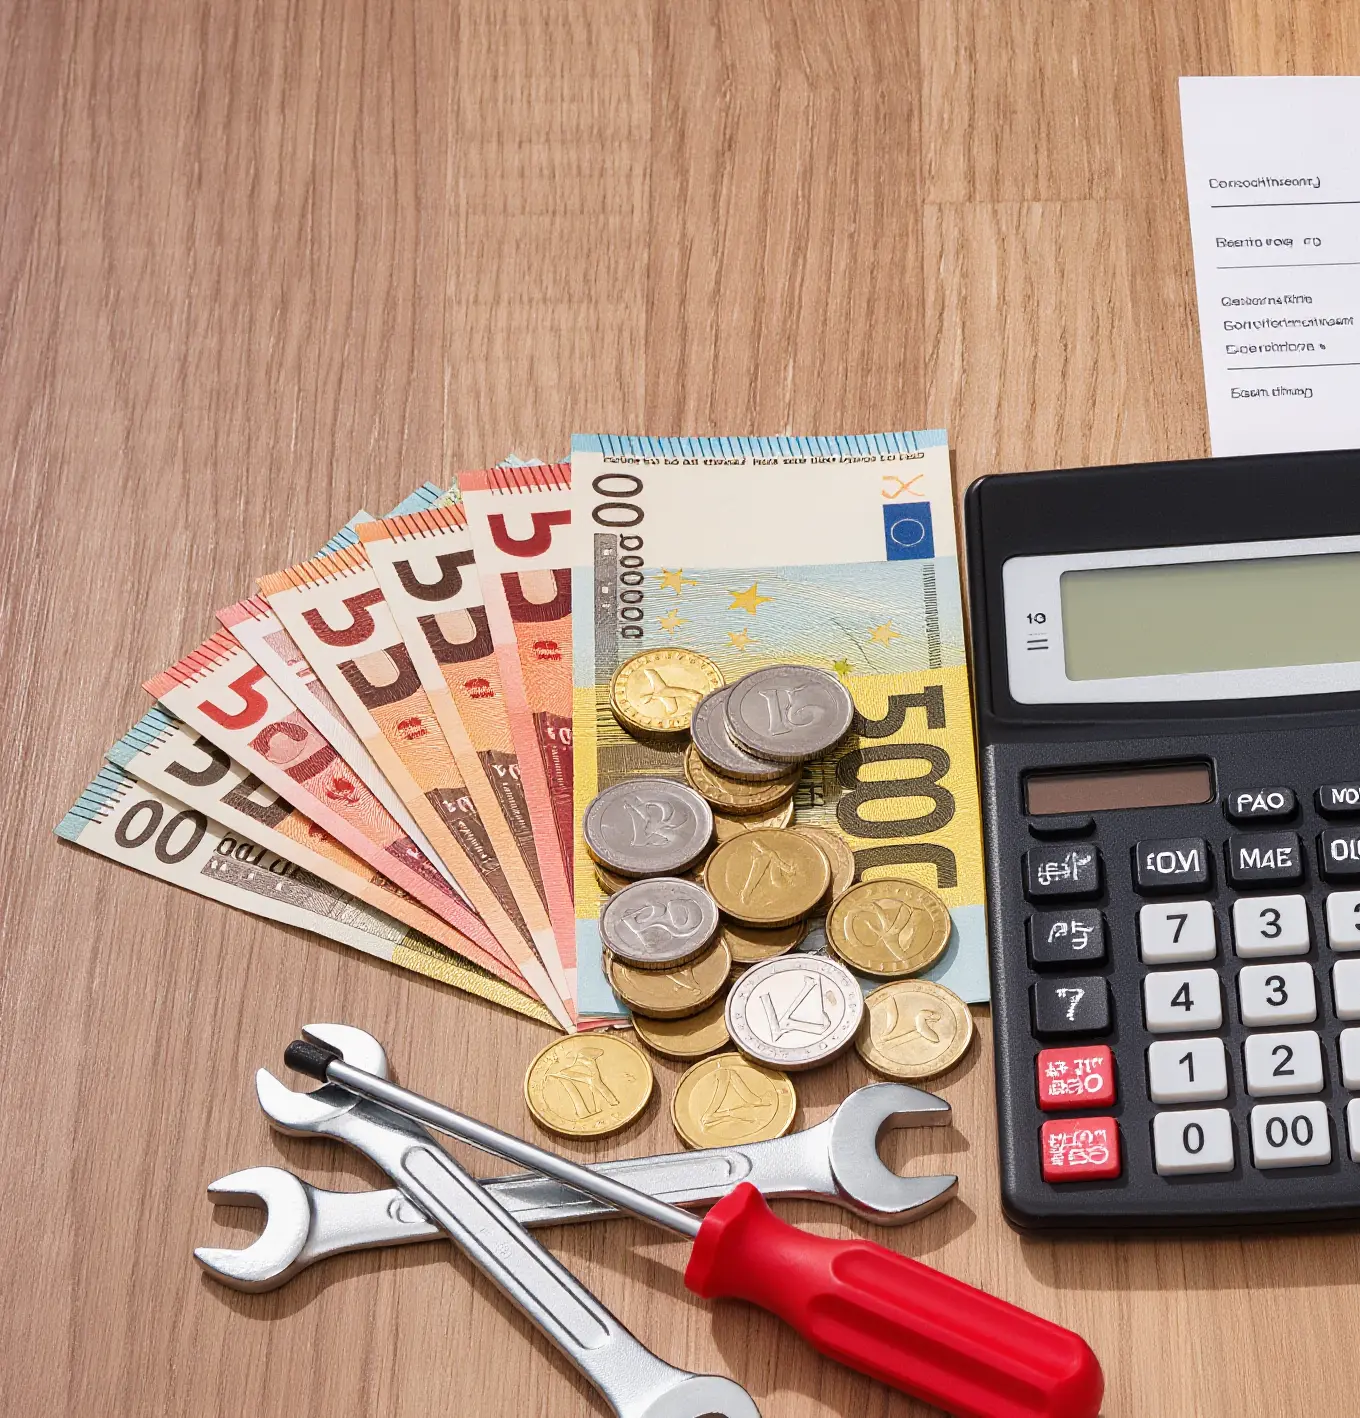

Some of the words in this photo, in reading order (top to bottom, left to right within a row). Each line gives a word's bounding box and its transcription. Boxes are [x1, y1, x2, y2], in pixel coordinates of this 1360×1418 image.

[1166, 913, 1189, 944] 7
[1259, 907, 1282, 939] 3
[1169, 981, 1195, 1012] 4
[1264, 974, 1289, 1007] 3
[1178, 1051, 1195, 1083] 1
[1270, 1044, 1295, 1077] 2
[1182, 1122, 1205, 1155] 0
[1265, 1114, 1314, 1148] 00
